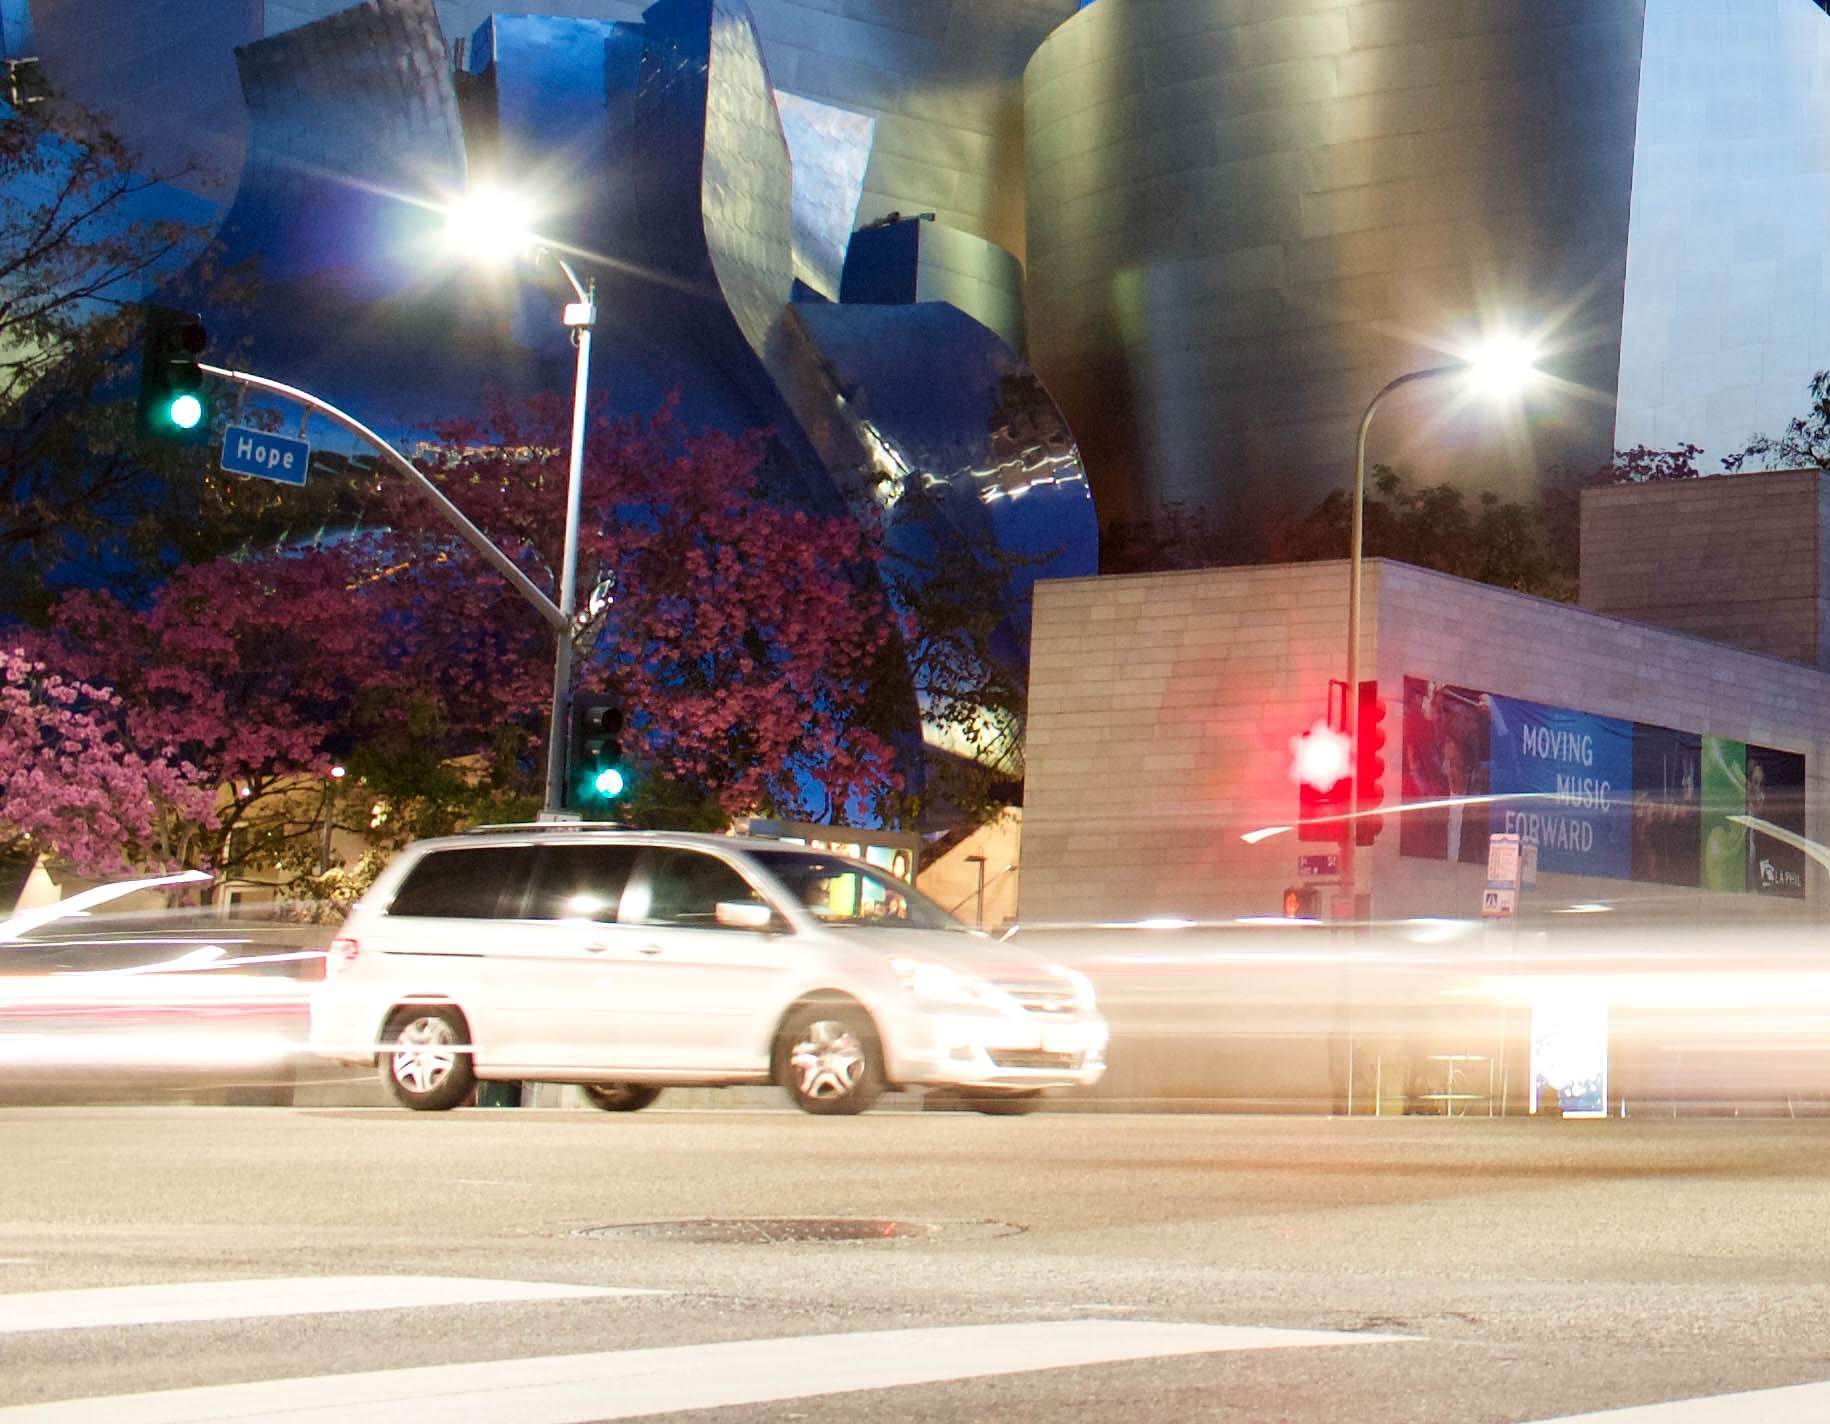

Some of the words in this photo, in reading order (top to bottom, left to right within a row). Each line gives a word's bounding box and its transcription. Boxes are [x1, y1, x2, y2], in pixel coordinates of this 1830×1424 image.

[237, 436, 294, 469] Hope
[1523, 724, 1593, 767] MOVING
[1556, 774, 1611, 813] MUSIC
[1505, 810, 1593, 852] FORWARD
